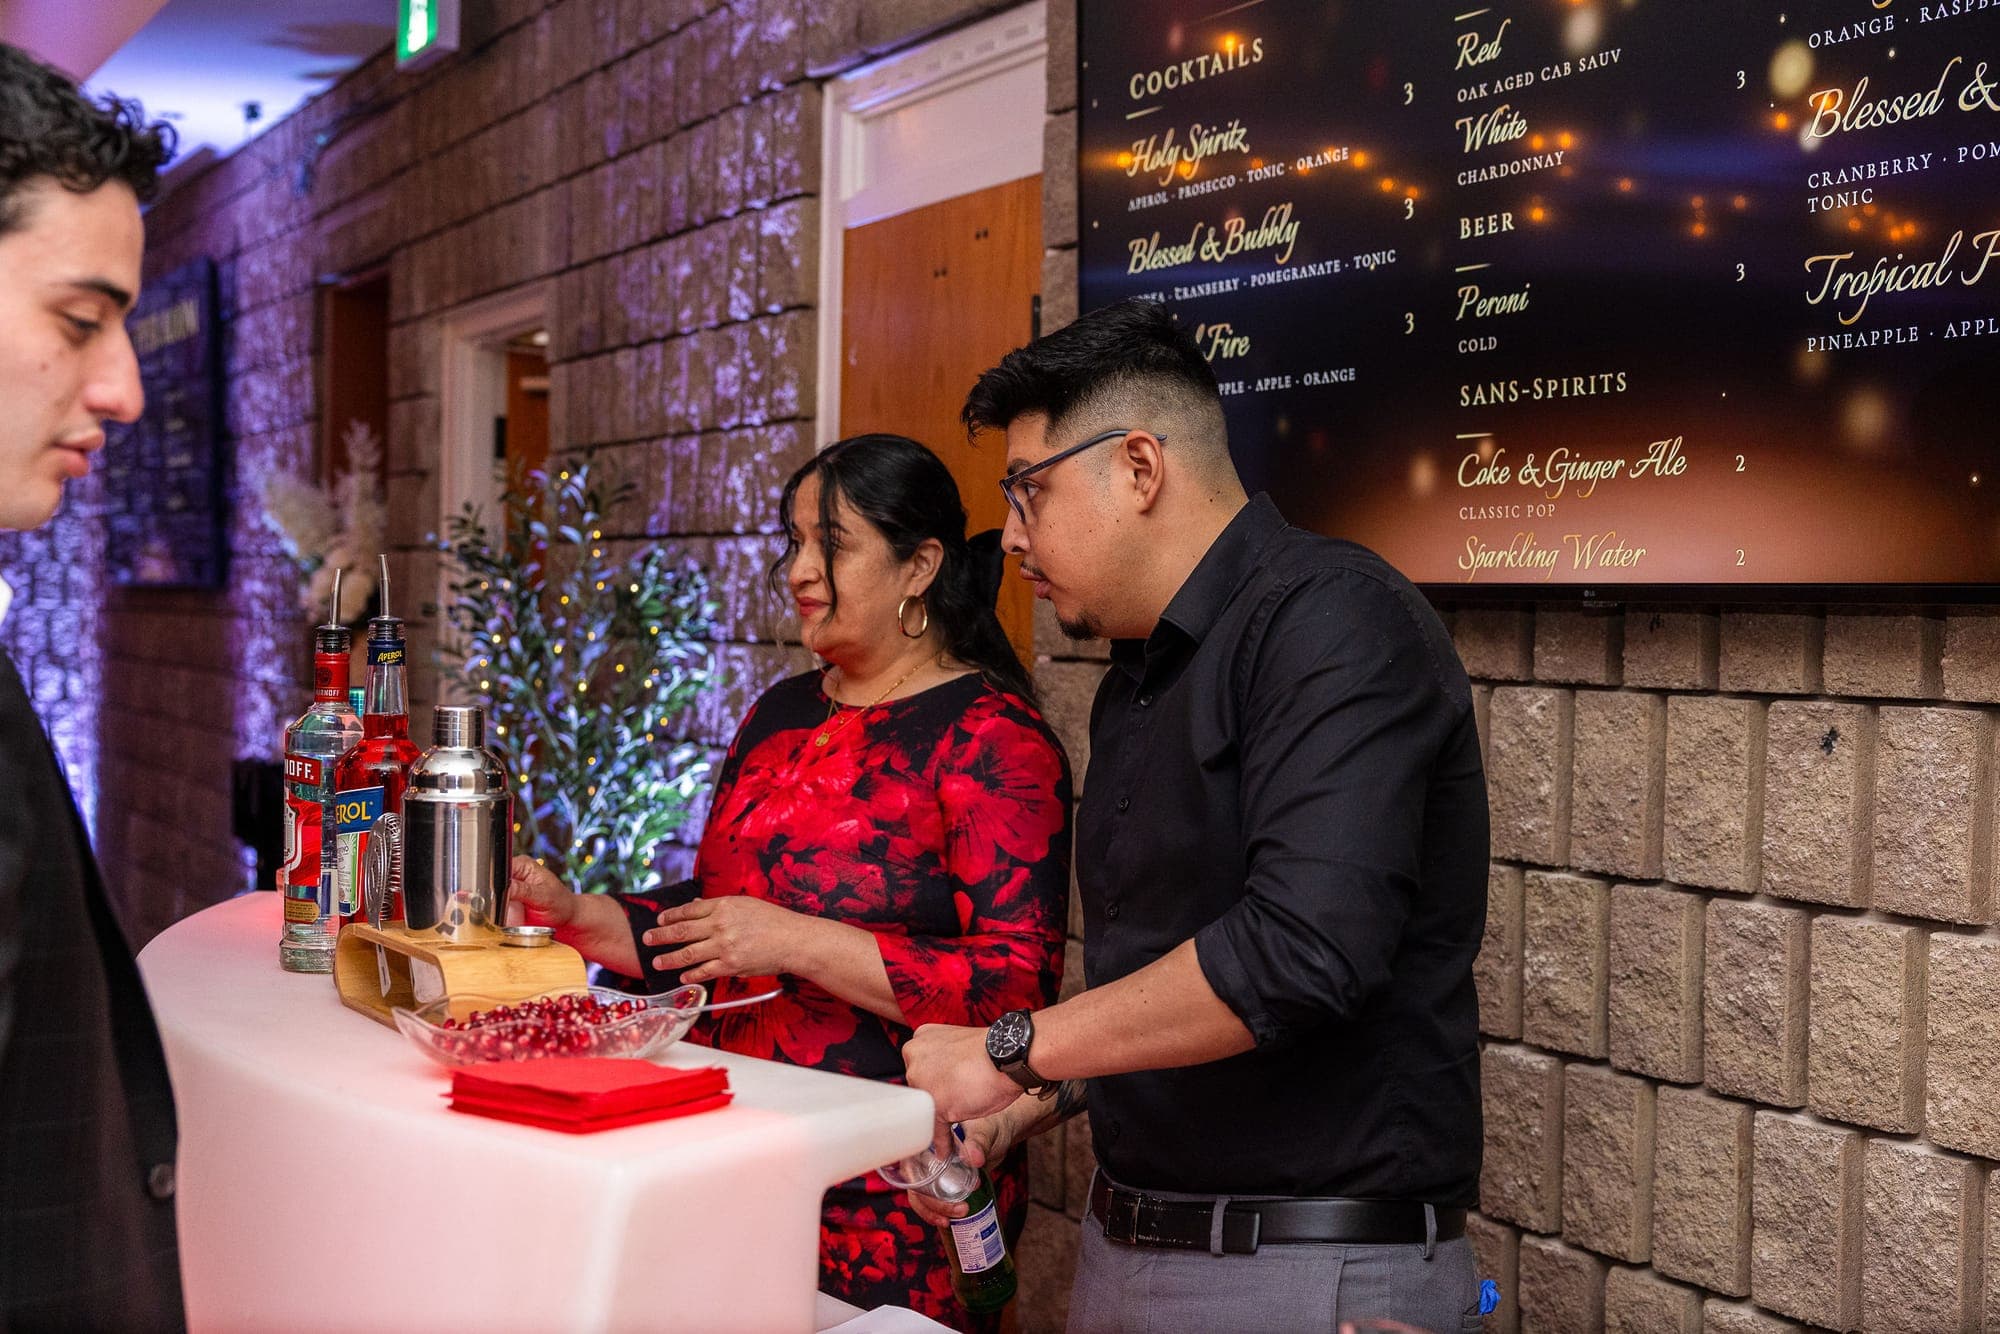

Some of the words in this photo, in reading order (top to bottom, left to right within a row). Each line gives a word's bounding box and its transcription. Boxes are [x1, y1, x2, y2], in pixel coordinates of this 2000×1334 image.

[1455, 18, 1511, 70] Red
[1807, 15, 1895, 49] ORANGE
[1129, 37, 1264, 101] COCKTAILS
[1457, 82, 1488, 103] OAK
[1493, 71, 1534, 94] AGED
[1541, 61, 1571, 82] CAB
[1578, 48, 1621, 73] SAUV
[1736, 70, 1745, 89] 3
[1404, 82, 1414, 105] 3
[1805, 56, 1962, 140] Blessed
[1958, 62, 2000, 112] &
[1455, 104, 1527, 153] White
[1126, 127, 1181, 187] Holy
[1181, 119, 1250, 181] Spiritz
[1457, 150, 1564, 186] CHARDONNAY
[1127, 191, 1168, 212] APEROL
[1178, 174, 1236, 200] PROSECCO
[1246, 163, 1285, 184] TONIC
[1296, 147, 1349, 171] ORANGE
[1807, 153, 1933, 189] CRANBERRY
[1404, 197, 1414, 220] 3
[1807, 189, 1873, 214] TONIC
[1127, 222, 1203, 275] Blessed
[1200, 227, 1226, 262] &
[1223, 202, 1300, 265] Bubbly
[1459, 212, 1515, 240] BEER
[1174, 278, 1239, 300] CRANBERRY
[1250, 258, 1341, 288] POMEGRANATE
[1354, 249, 1396, 270] TONIC
[1736, 263, 1745, 282] 3
[1804, 230, 1963, 326] Tropical
[1456, 283, 1531, 321] Peroni
[1404, 312, 1414, 334] 3
[1807, 327, 1919, 352] PINEAPPLE
[1944, 318, 2000, 339] APPL
[1202, 323, 1250, 362] Fire
[1458, 336, 1497, 353] COLD
[1255, 375, 1292, 392] APPLE
[1303, 367, 1356, 387] ORANGE
[1460, 372, 1627, 407] SANS-SPIRITS
[1457, 448, 1511, 488] Coke
[1518, 453, 1547, 488] &
[1545, 447, 1625, 499] Ginger
[1629, 435, 1687, 479] Ale
[1735, 455, 1746, 472] 2
[1459, 505, 1521, 520] CLASSIC
[1527, 503, 1556, 518] POP
[1458, 531, 1560, 583] Sparkling
[1563, 530, 1647, 570] Water
[1735, 549, 1746, 566] 2
[377, 650, 403, 662] APEROL
